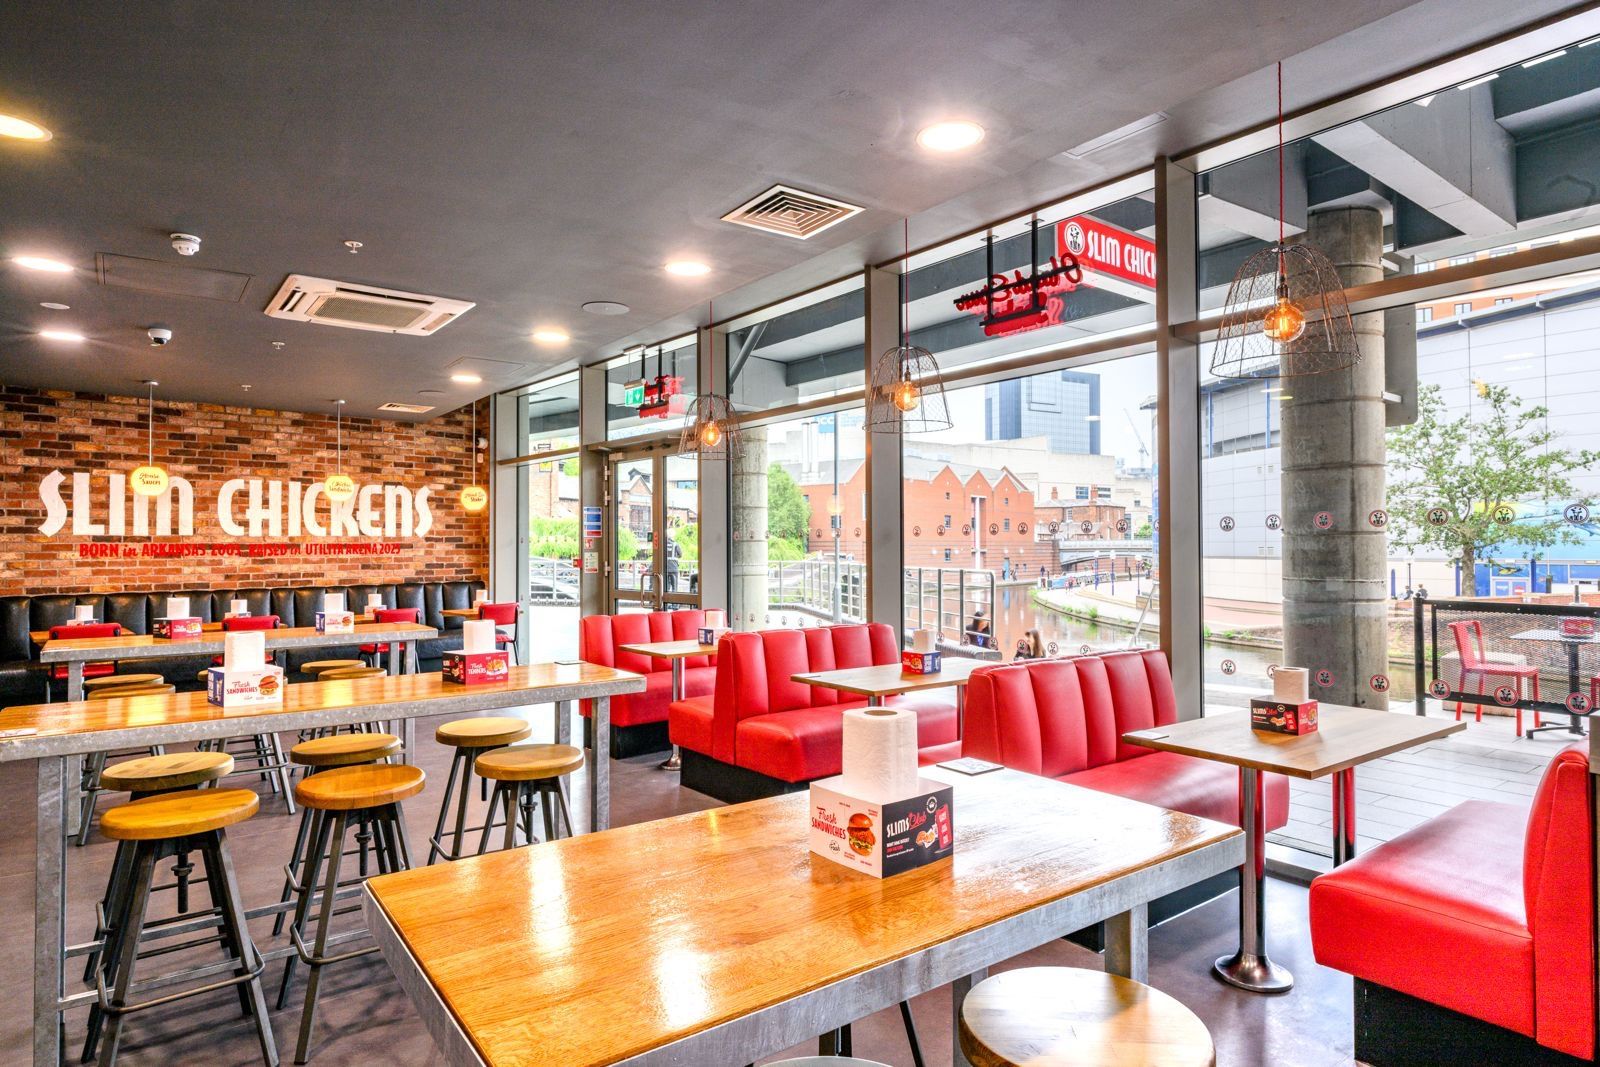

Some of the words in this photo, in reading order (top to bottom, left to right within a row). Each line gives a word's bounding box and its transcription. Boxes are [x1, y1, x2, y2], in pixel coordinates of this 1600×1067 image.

[1087, 229, 1121, 268] SLIM
[38, 470, 194, 537] SLIM
[217, 478, 433, 538] CHICKENS
[79, 543, 119, 558] BORN
[123, 544, 139, 557] in
[141, 543, 207, 557] ARKANSAS
[249, 543, 288, 557] RAISED
[305, 543, 344, 555] UTILITA
[345, 543, 379, 555] ARENA
[816, 806, 837, 824] Fresh
[812, 816, 846, 840] SANDWICHES
[886, 817, 910, 838] SLIMS
